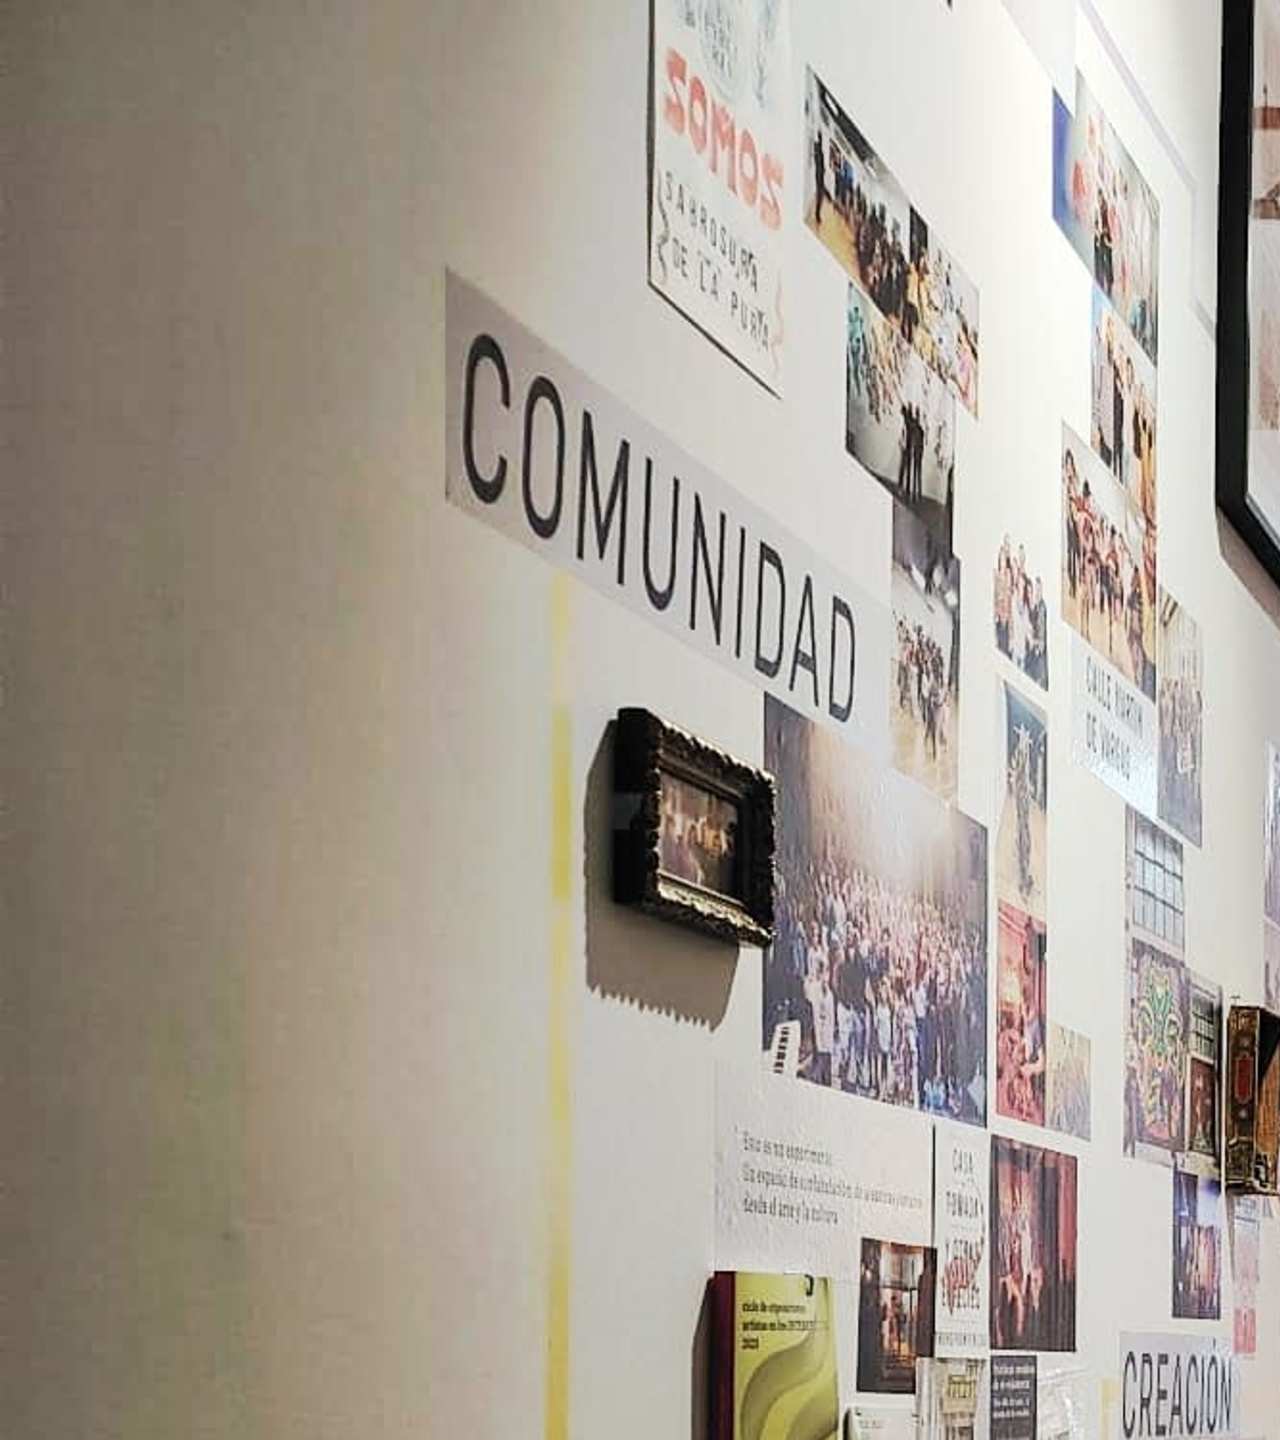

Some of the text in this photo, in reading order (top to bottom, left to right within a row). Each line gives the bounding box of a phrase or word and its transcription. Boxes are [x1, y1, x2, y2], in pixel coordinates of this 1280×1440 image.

[663, 47, 783, 231] SOMOS
[463, 333, 856, 723] COMUNIDAD
[1121, 1338, 1233, 1440] CREACIÓN
